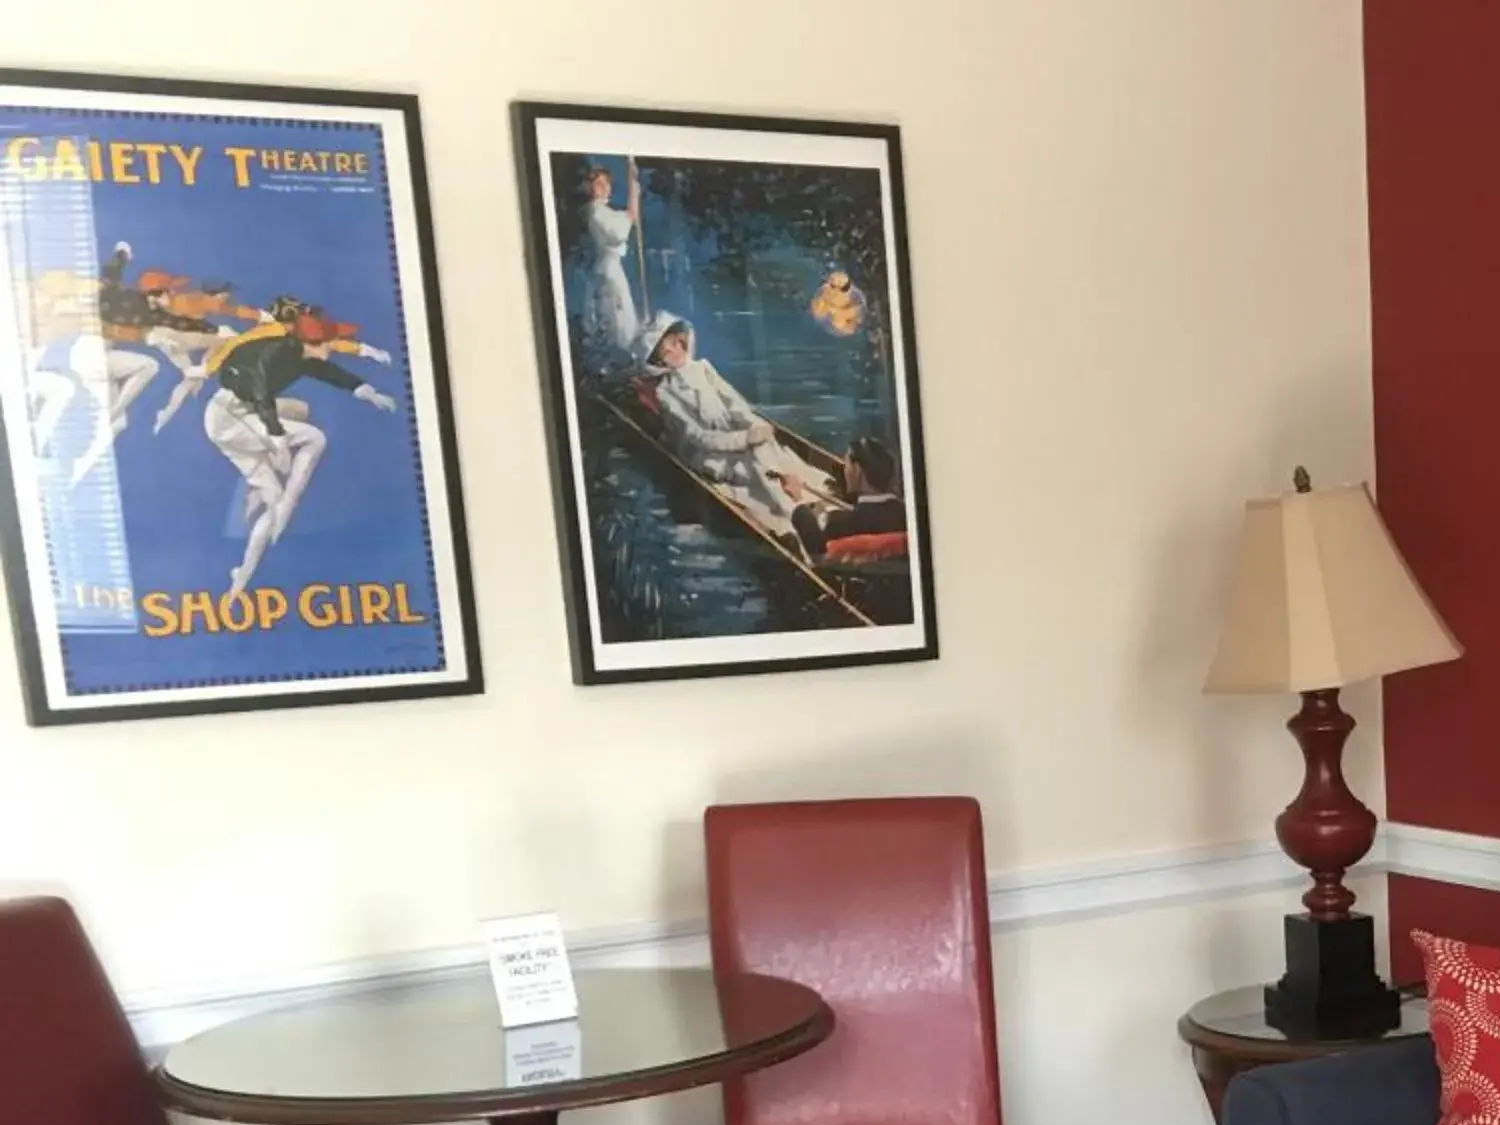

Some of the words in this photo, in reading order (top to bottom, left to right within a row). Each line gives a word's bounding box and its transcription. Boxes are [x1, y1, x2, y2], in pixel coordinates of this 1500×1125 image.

[6, 135, 203, 187] GAIETY
[225, 146, 371, 189] THEATRE
[141, 586, 289, 637] SHOP
[297, 581, 430, 629] GIRL
